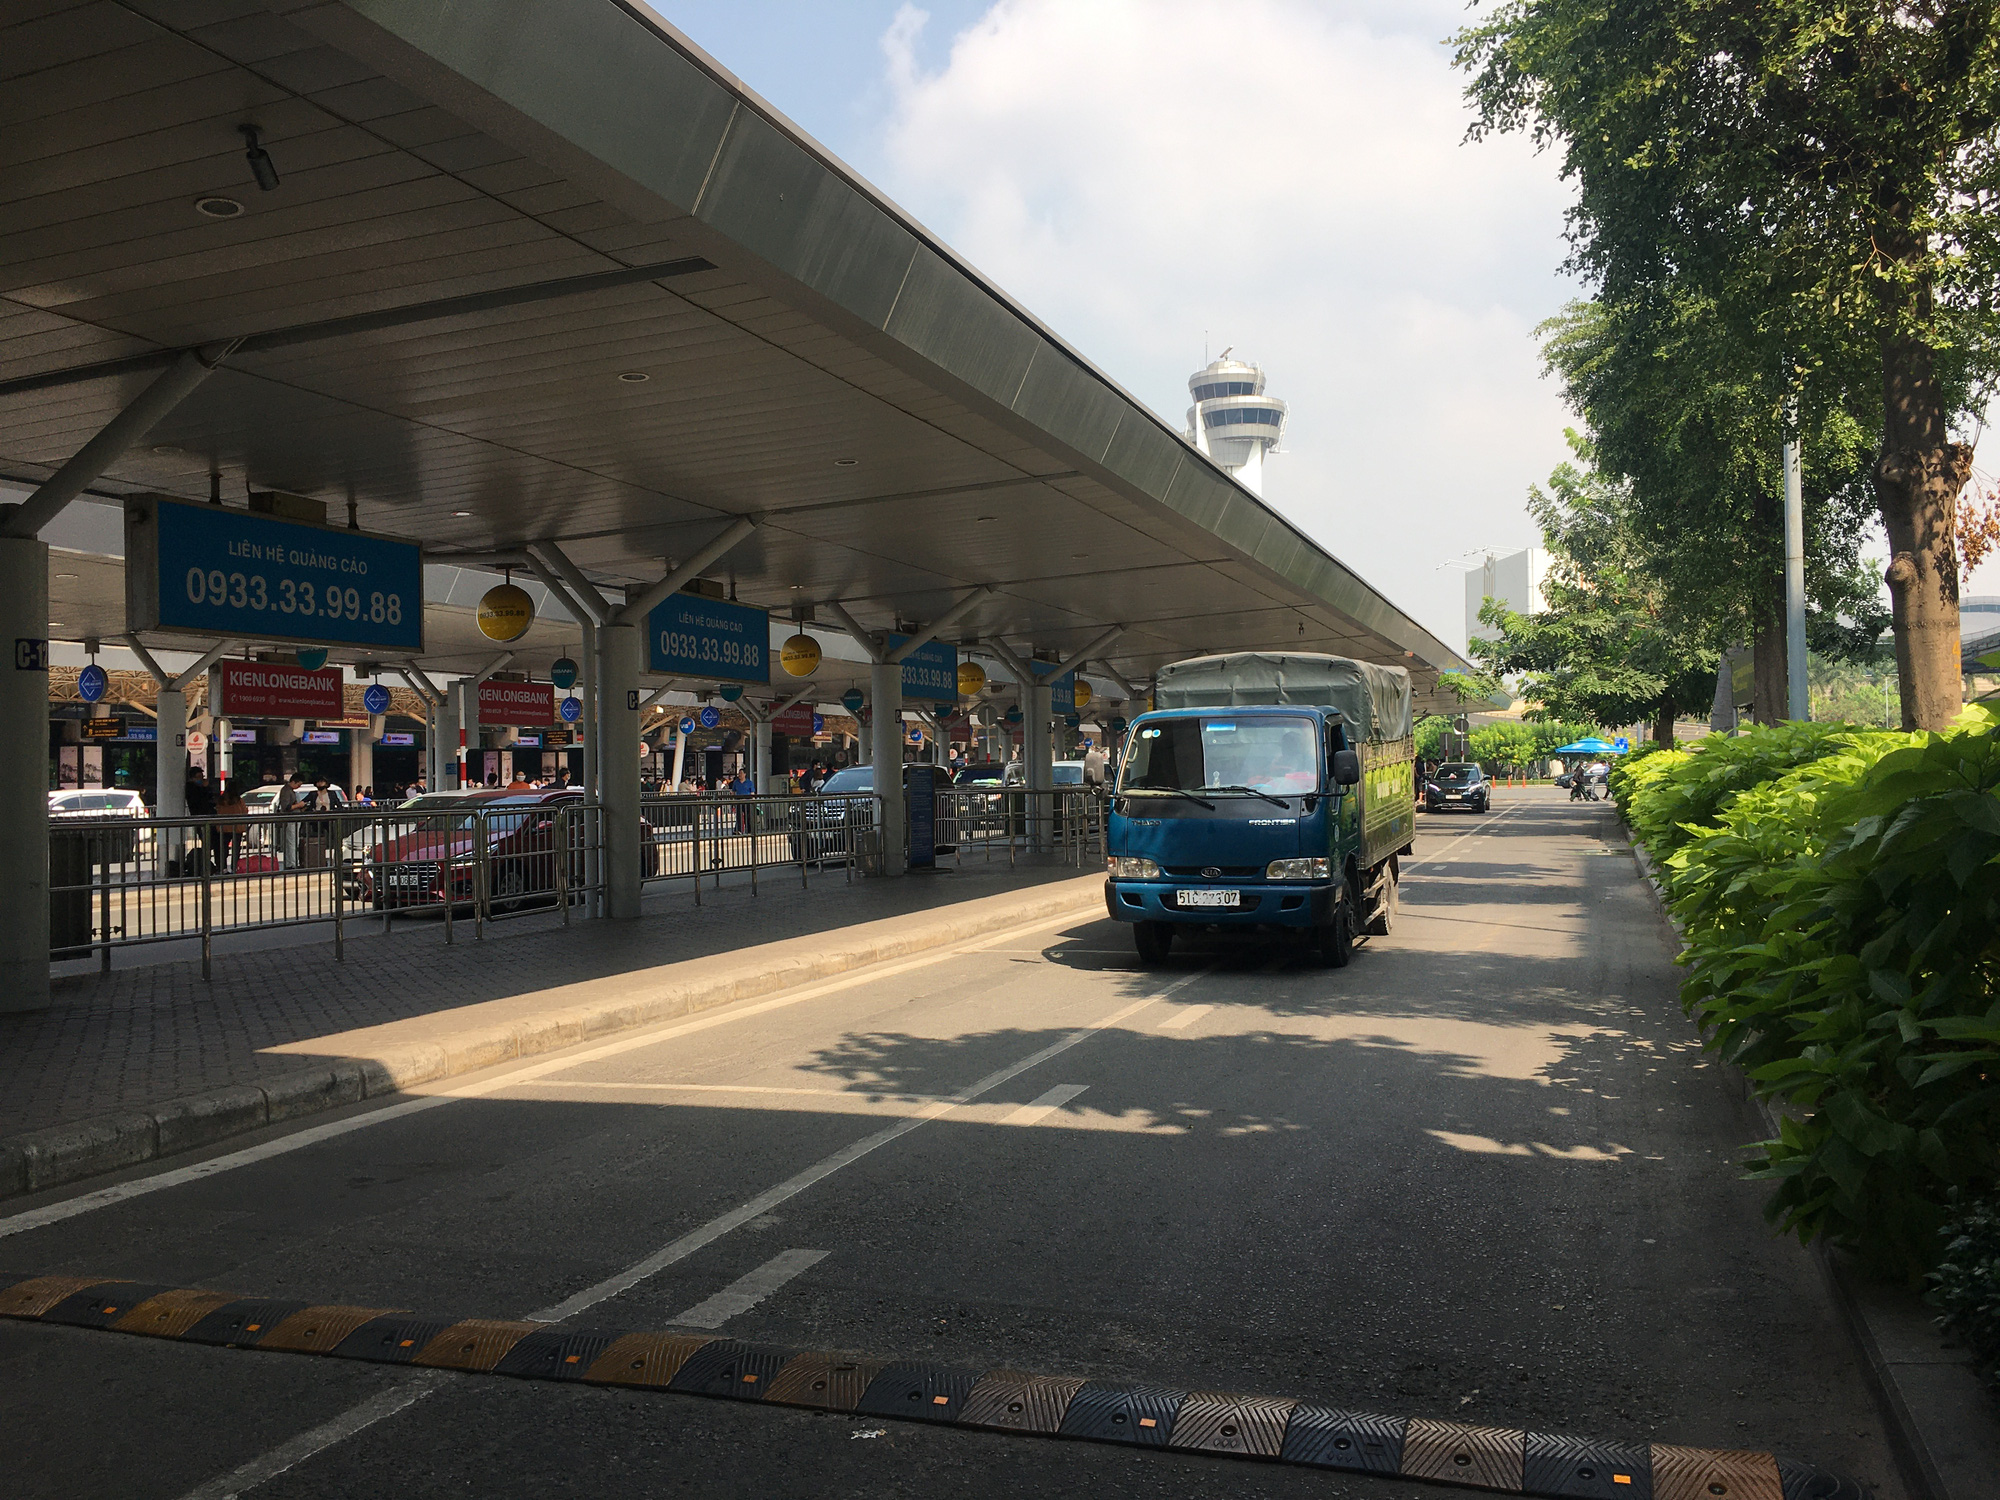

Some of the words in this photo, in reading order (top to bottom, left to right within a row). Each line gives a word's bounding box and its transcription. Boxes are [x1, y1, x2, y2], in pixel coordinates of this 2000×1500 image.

[228, 539, 261, 559] LIÊN
[266, 545, 284, 565] HỆ
[289, 548, 337, 570] QUẢNG
[340, 556, 367, 575] CÁO
[186, 567, 402, 626] 0933.33.99.88
[660, 630, 759, 667] 0933.33.99.88
[230, 671, 335, 692] KIENLONGBANK
